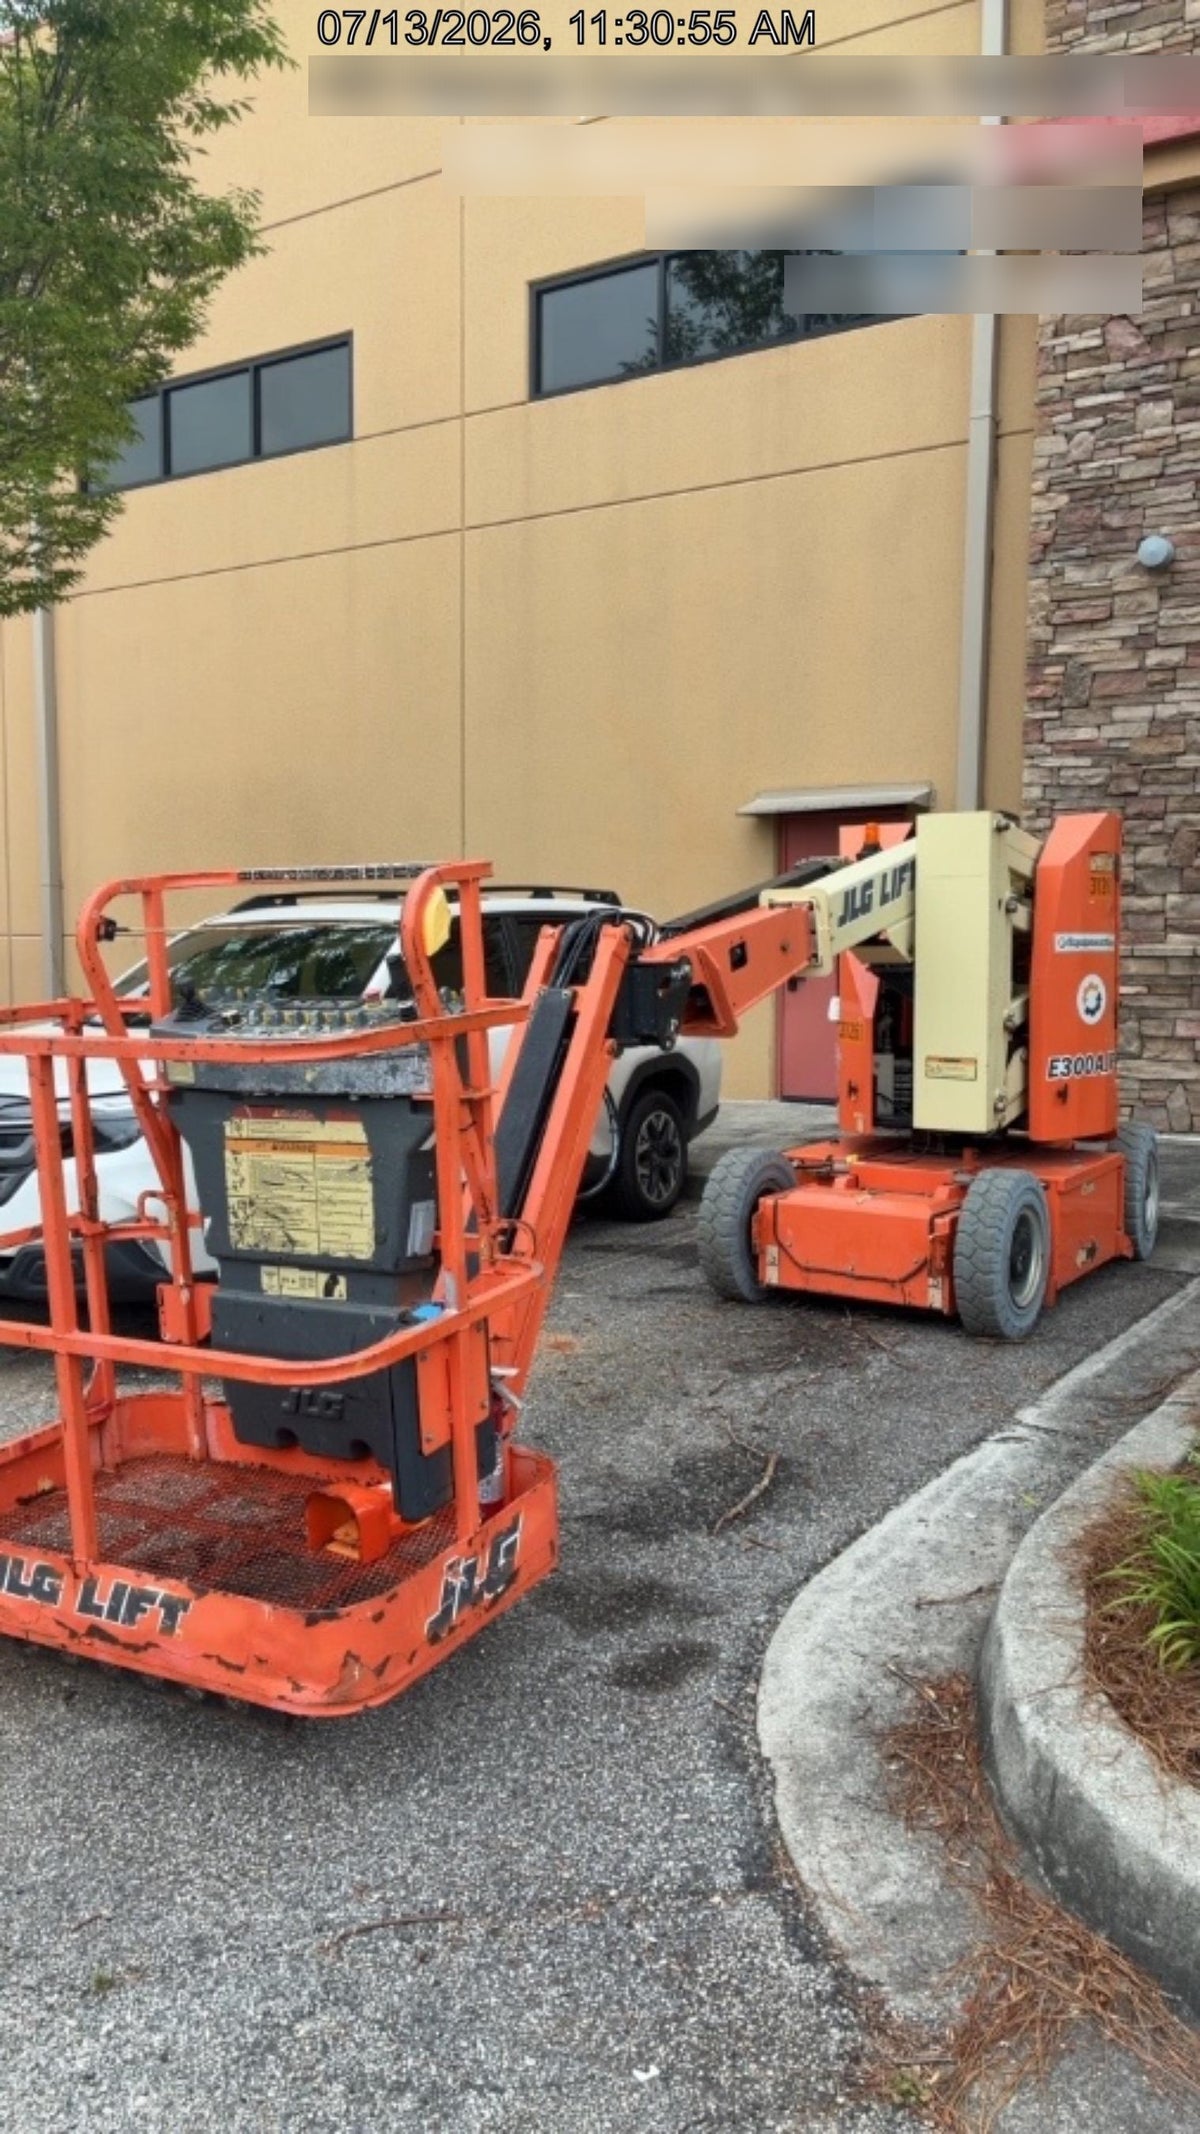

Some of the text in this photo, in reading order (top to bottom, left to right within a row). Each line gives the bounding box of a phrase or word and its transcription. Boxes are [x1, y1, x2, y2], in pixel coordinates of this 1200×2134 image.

[837, 879, 875, 928] JLG
[281, 1386, 344, 1420] JLG
[424, 1508, 524, 1645] JLG
[75, 1577, 194, 1637] LIFT
